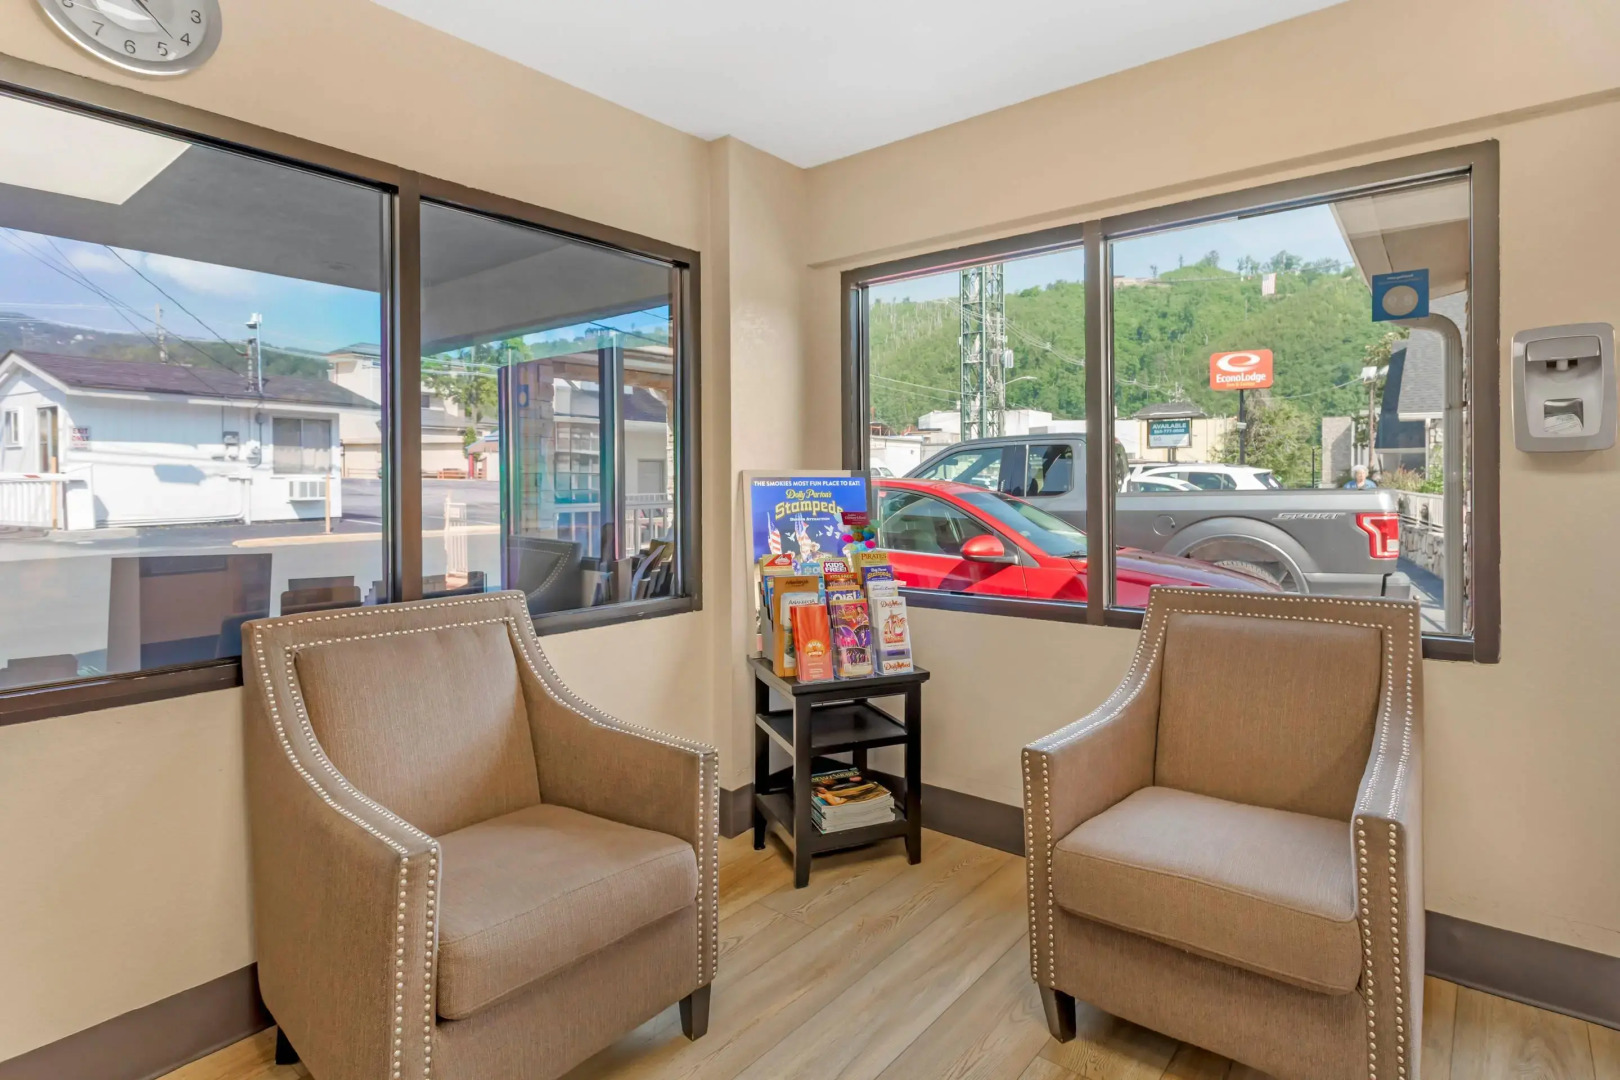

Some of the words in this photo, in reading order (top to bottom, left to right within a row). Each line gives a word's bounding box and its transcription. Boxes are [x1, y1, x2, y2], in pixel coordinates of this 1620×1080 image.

[190, 10, 202, 24] 3
[92, 20, 105, 36] 7
[180, 32, 191, 46] 4
[123, 39, 136, 54] 6
[157, 41, 169, 57] 5
[786, 489, 806, 500] Dolly
[806, 489, 832, 499] Parton's
[1272, 512, 1346, 520] SPORT
